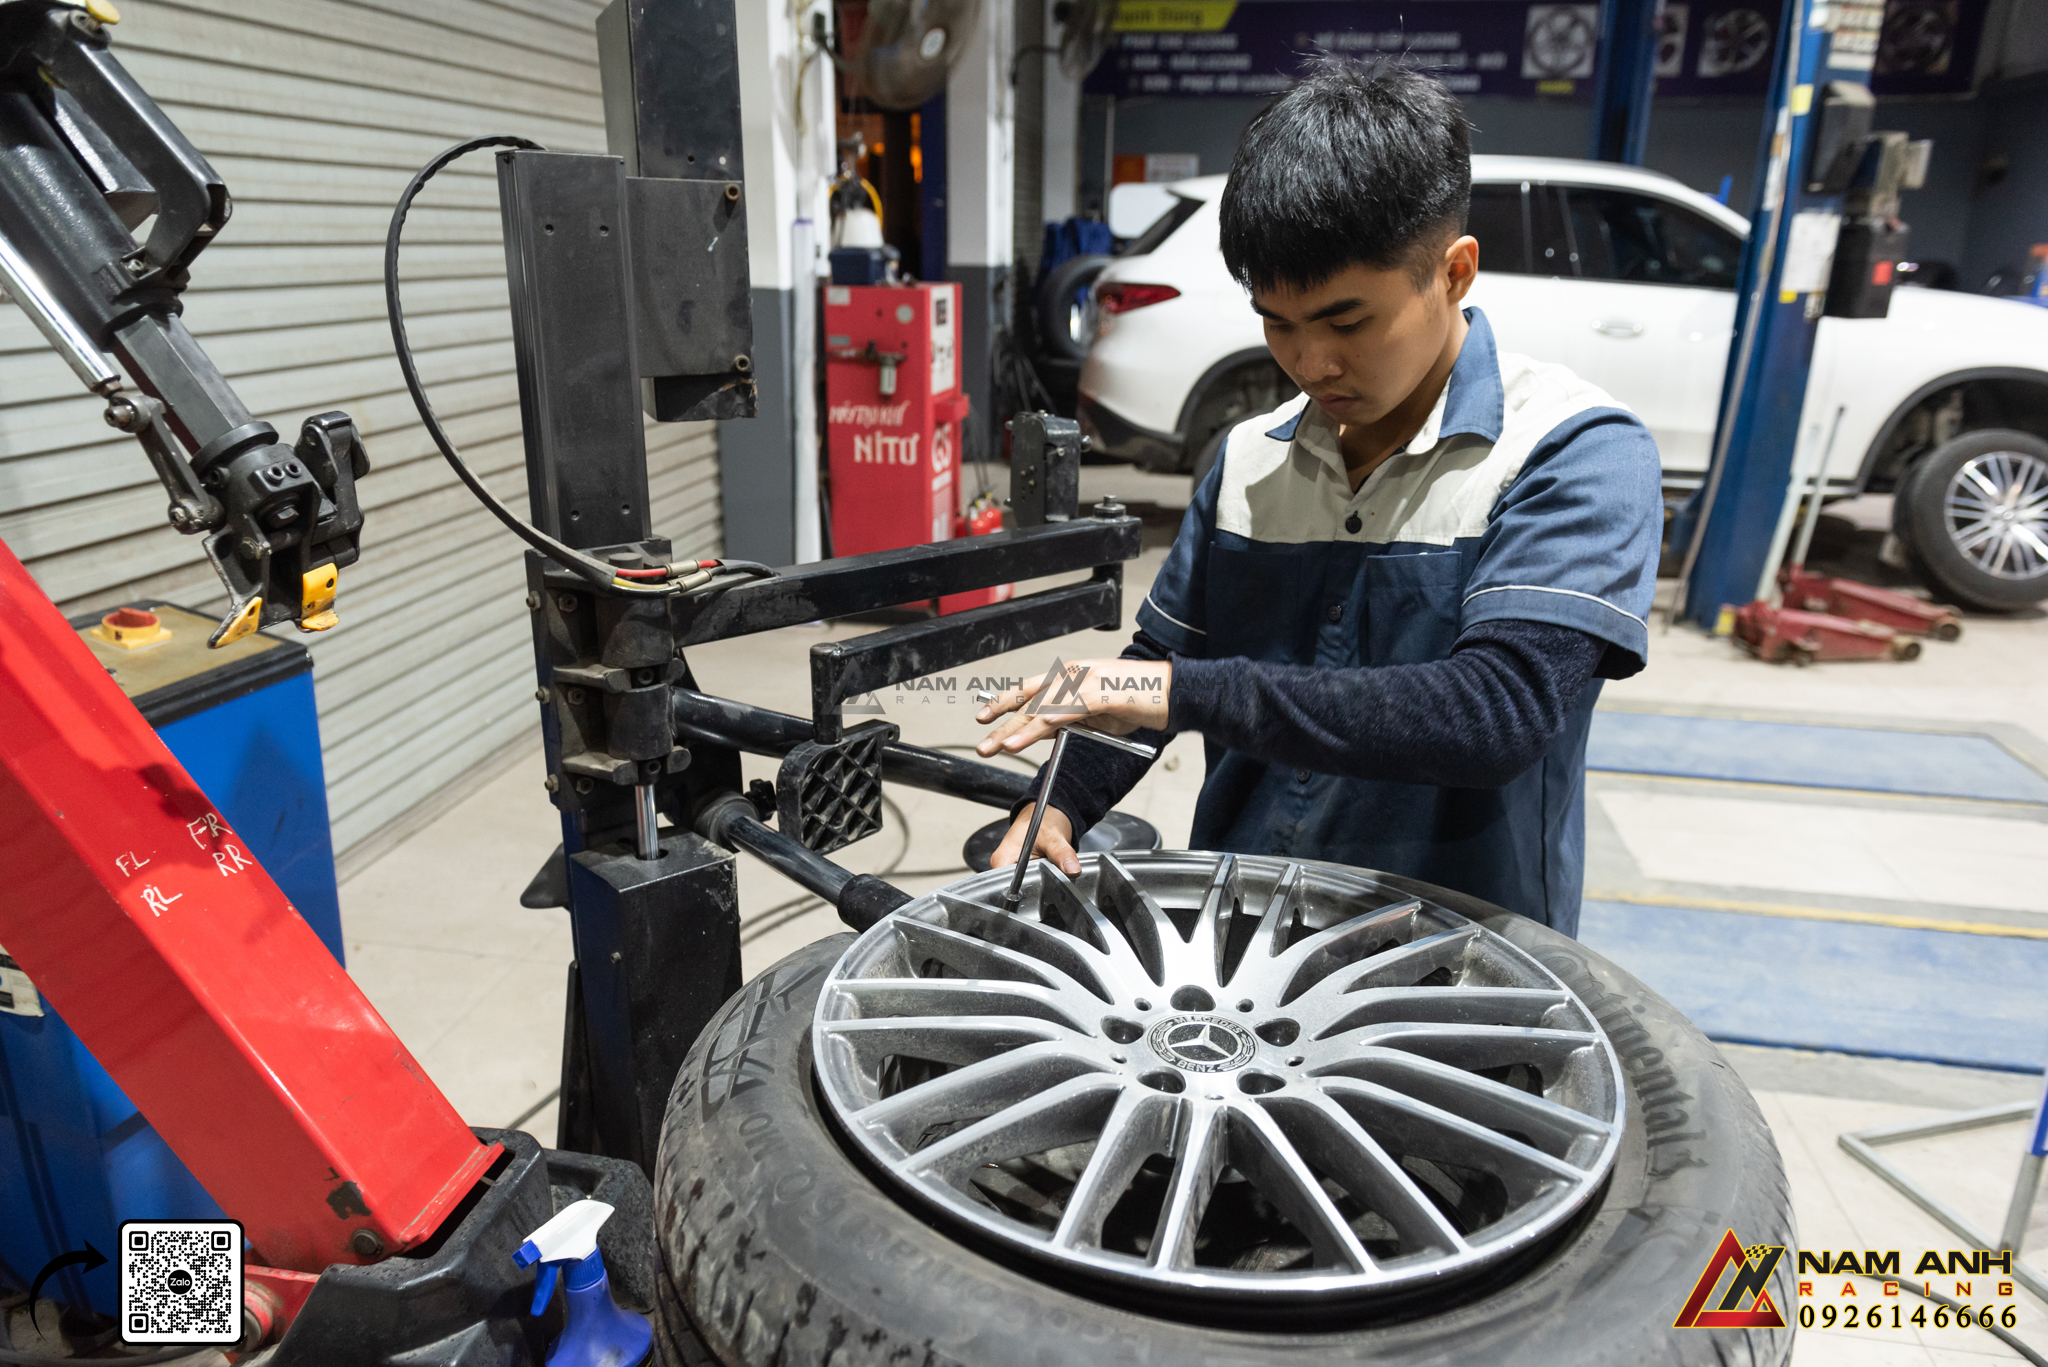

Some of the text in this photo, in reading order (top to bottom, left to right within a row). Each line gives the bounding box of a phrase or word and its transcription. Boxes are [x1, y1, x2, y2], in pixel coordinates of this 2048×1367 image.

[186, 812, 233, 850] FR
[115, 851, 151, 878] FL
[212, 844, 253, 877] RR
[140, 884, 183, 917] RL
[1174, 1015, 1243, 1035] MERCEDES
[1177, 1060, 1216, 1072] BENZ
